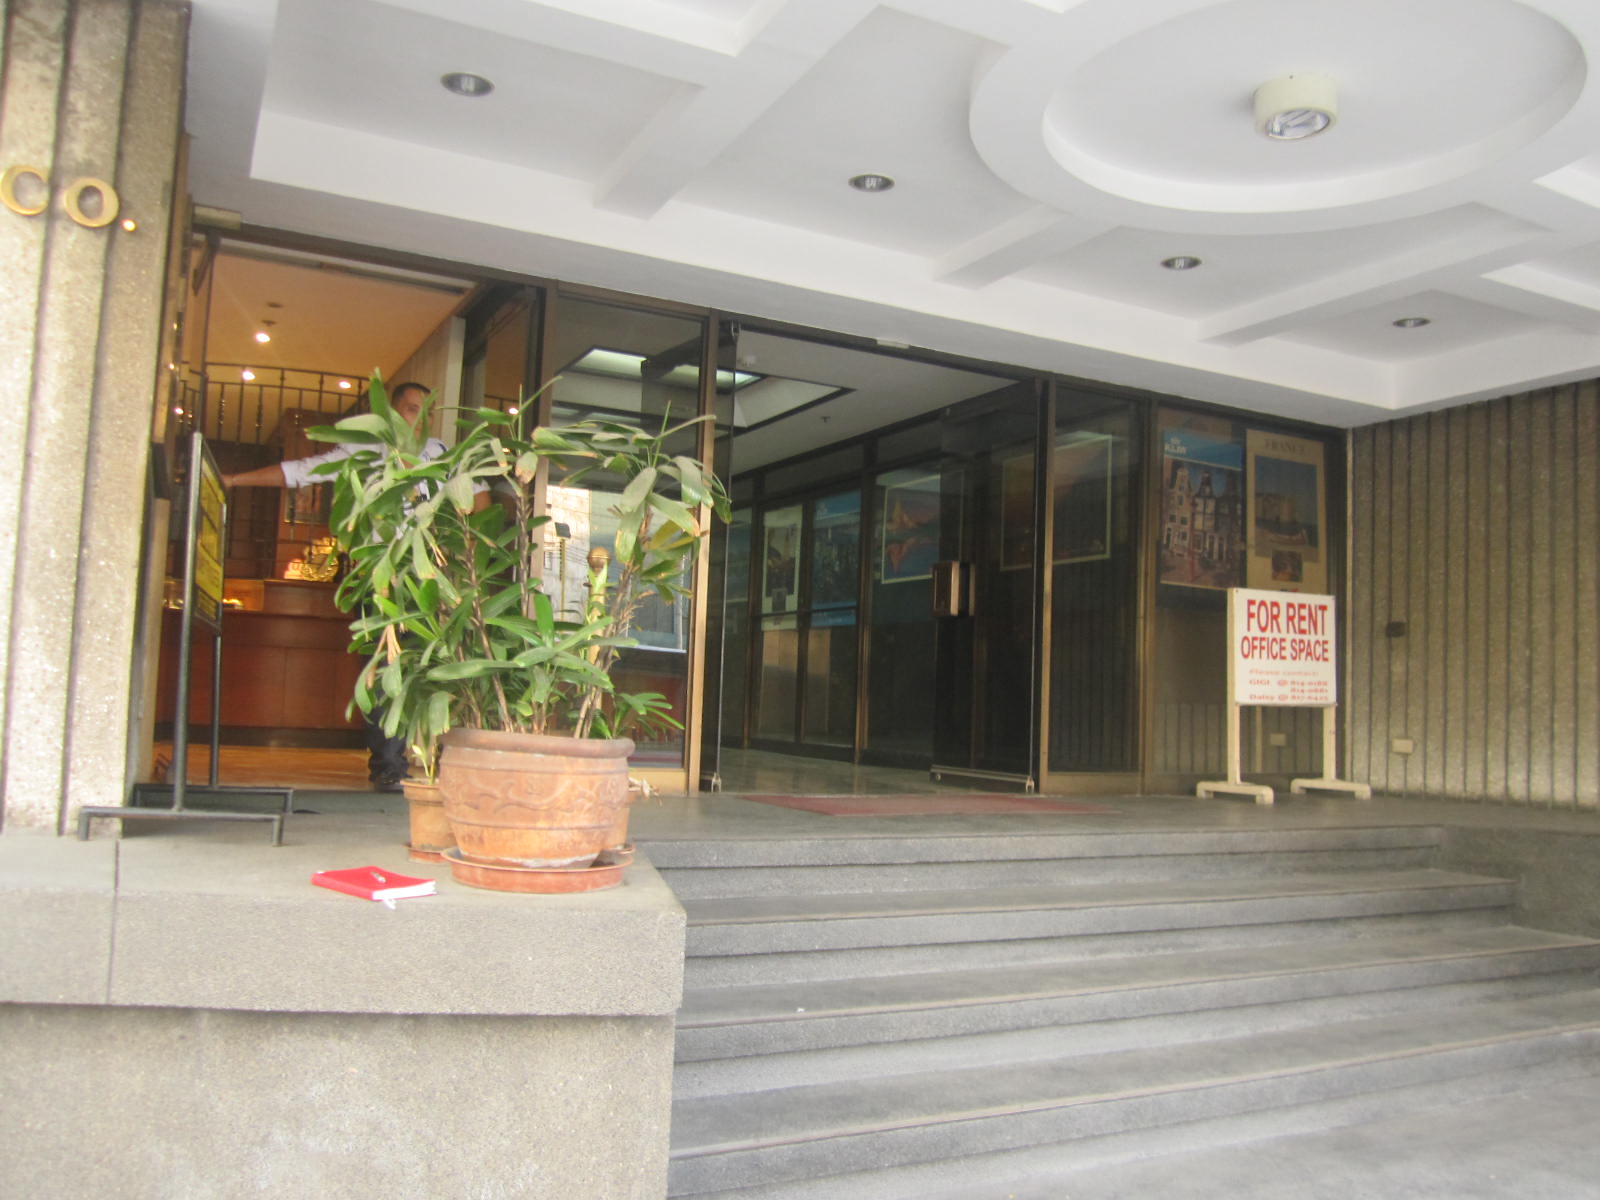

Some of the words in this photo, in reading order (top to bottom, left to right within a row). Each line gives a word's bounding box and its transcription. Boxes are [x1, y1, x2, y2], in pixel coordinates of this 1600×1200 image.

[1247, 599, 1281, 634] FOR
[1286, 602, 1328, 636] RENT
[1241, 635, 1287, 660] OFFICE
[1290, 638, 1329, 662] SPACE
